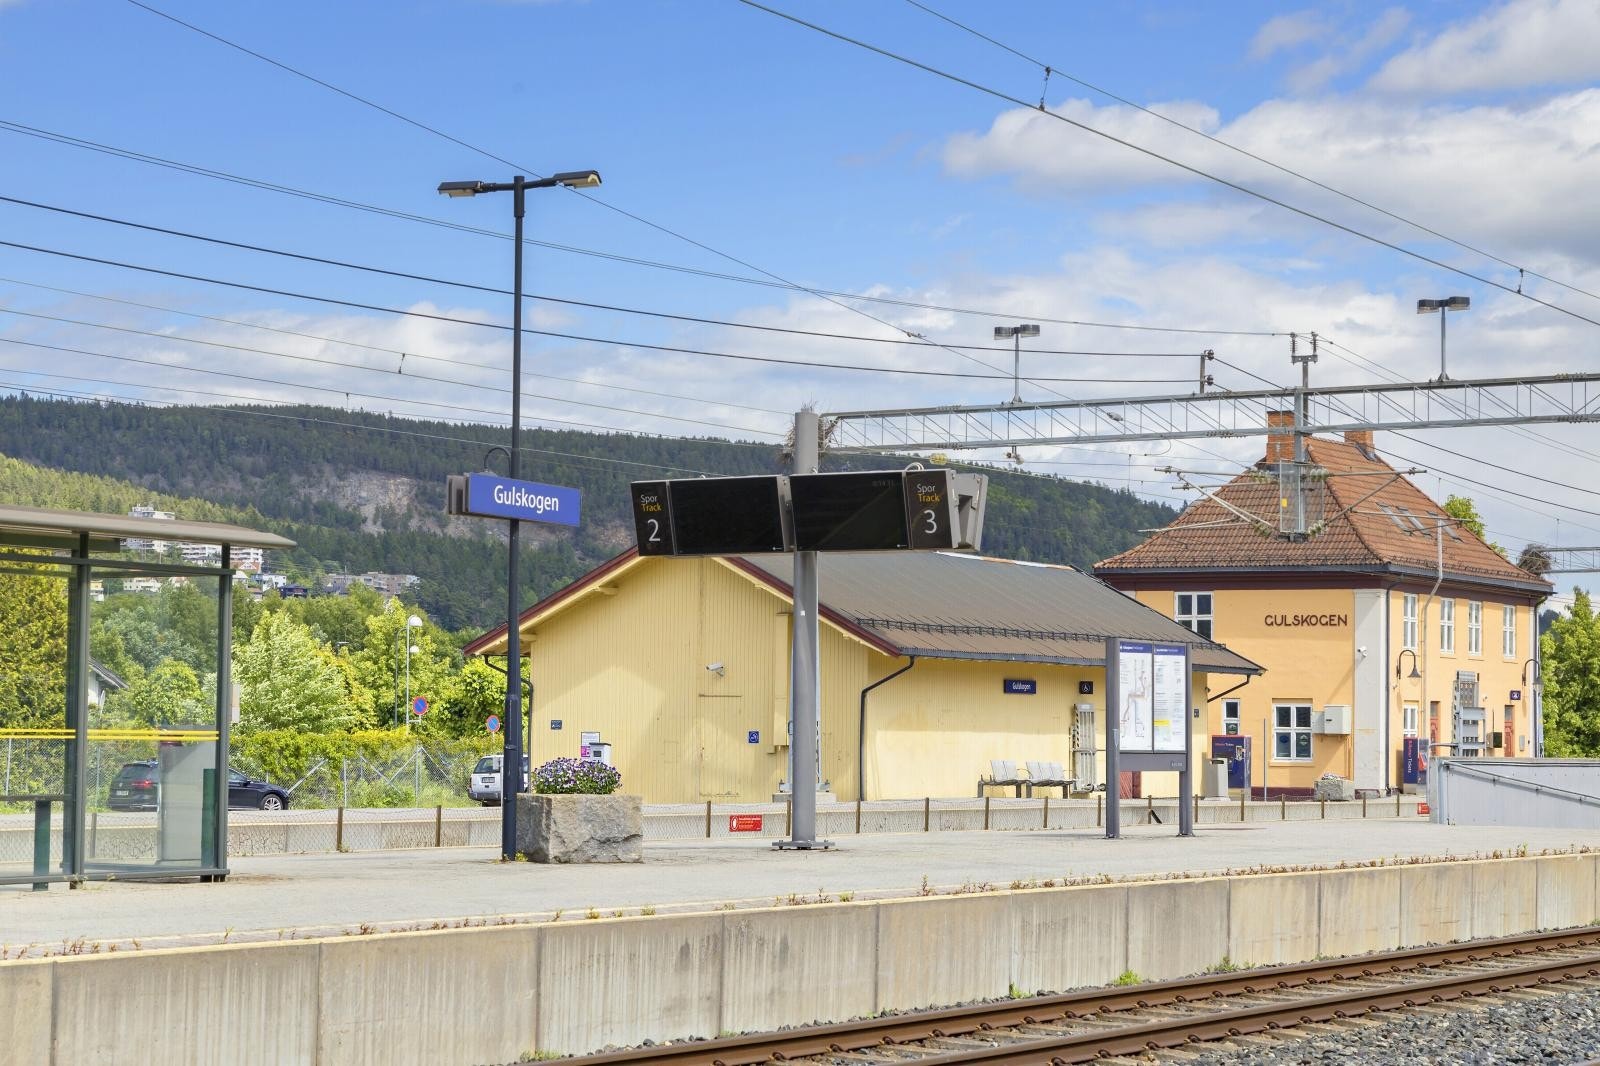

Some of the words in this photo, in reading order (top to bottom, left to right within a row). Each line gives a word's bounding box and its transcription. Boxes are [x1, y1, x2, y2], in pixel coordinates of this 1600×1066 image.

[917, 483, 936, 494] Spor
[494, 485, 559, 514] Gulskogen
[640, 494, 658, 503] Spor
[919, 493, 940, 502] Track
[642, 503, 662, 512] Track
[923, 509, 938, 534] 3
[647, 518, 661, 542] 2
[1264, 614, 1347, 627] GULSKOGEN
